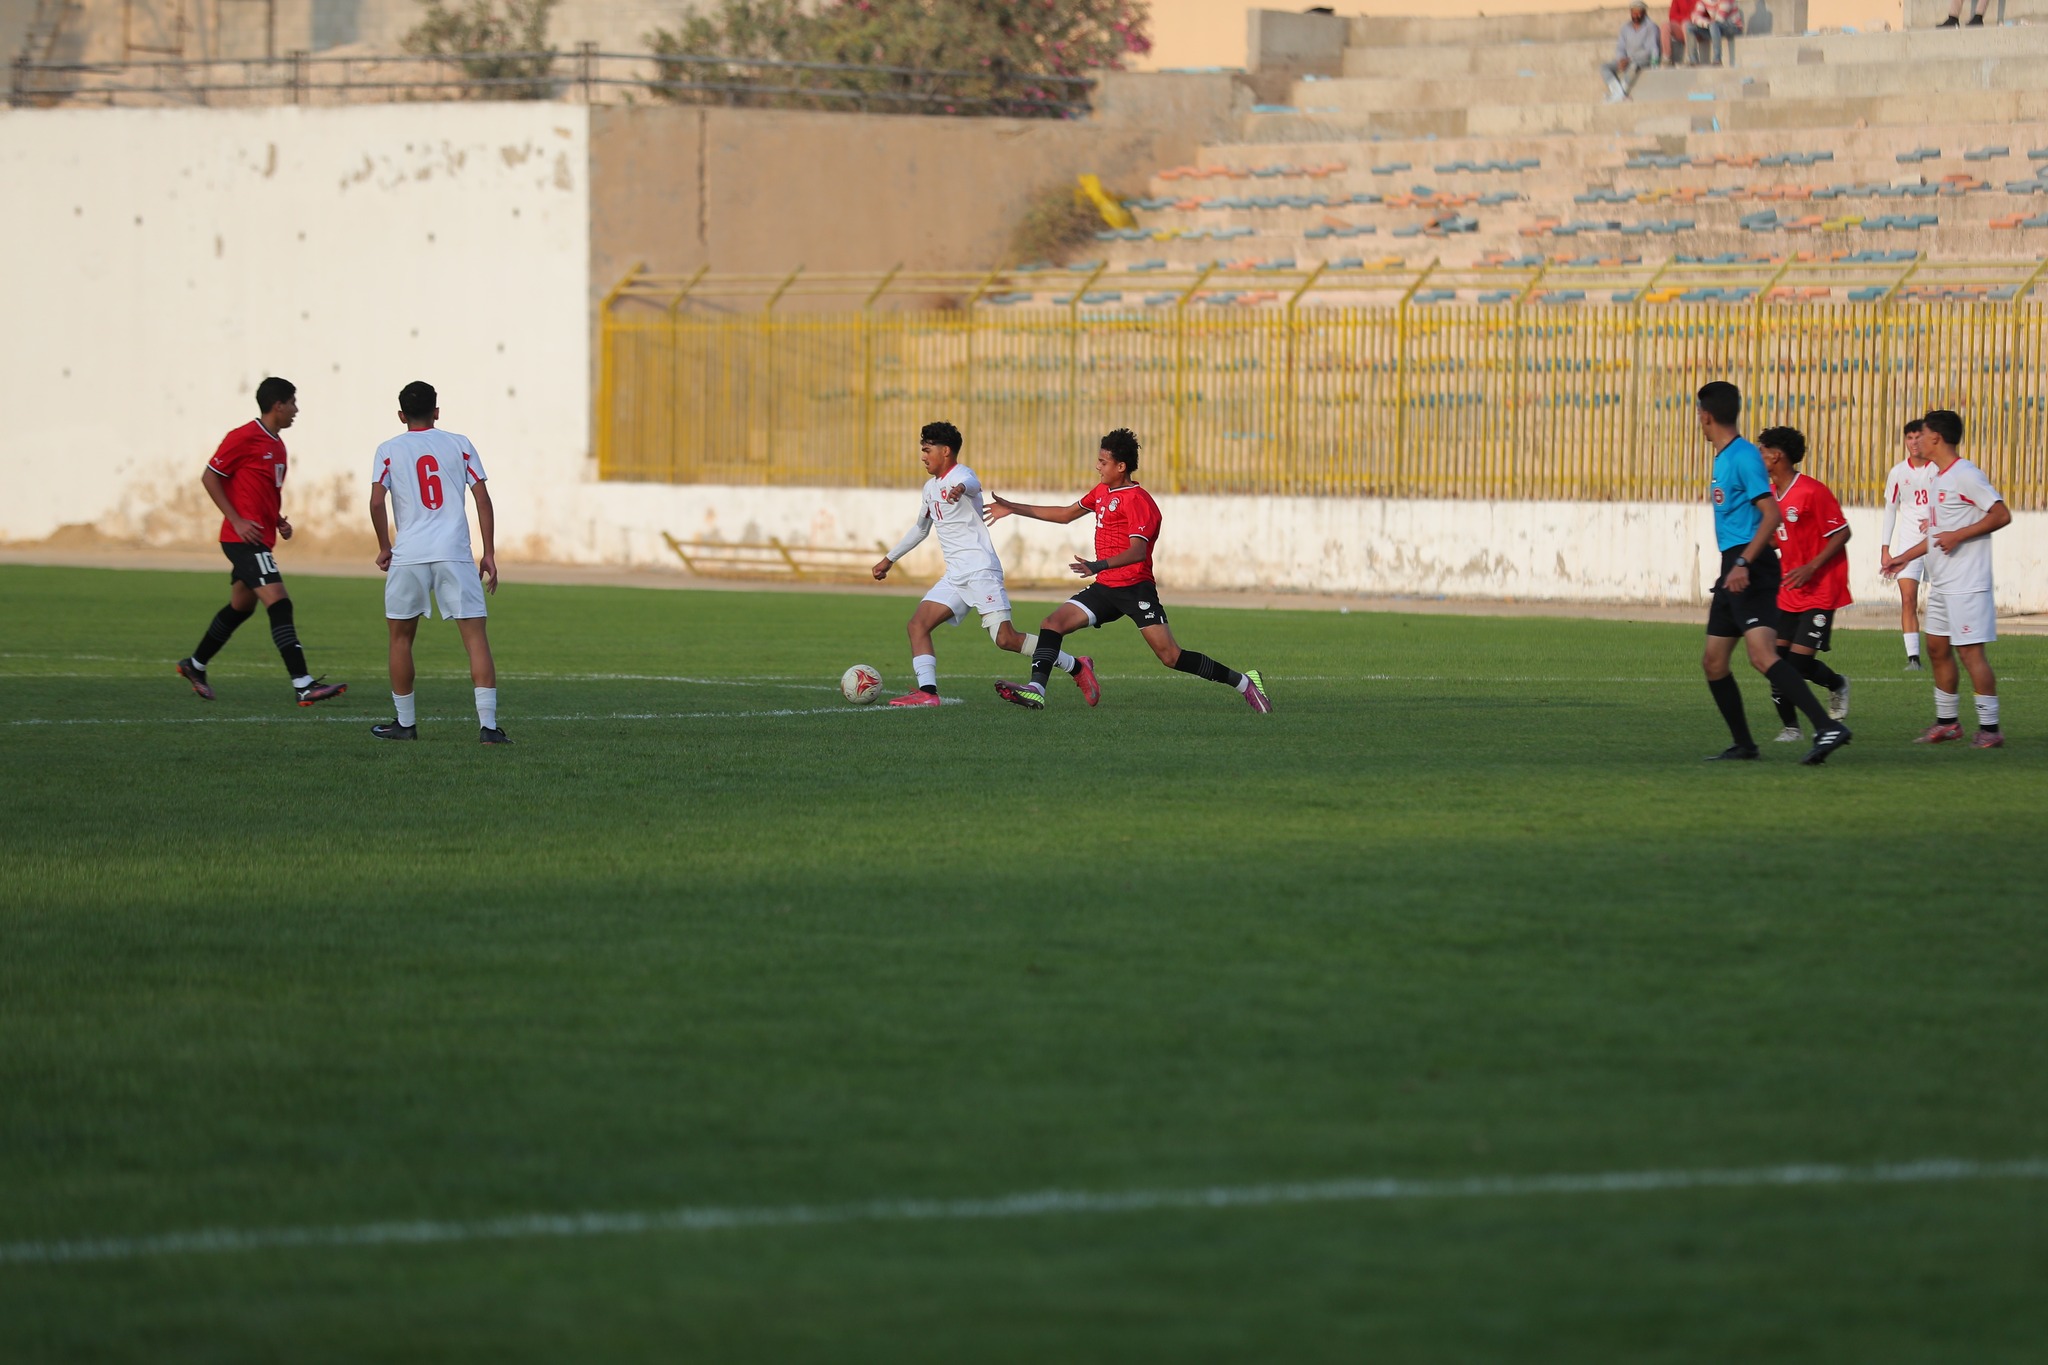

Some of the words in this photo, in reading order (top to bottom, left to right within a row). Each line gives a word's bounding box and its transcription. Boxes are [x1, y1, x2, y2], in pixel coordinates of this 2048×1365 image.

[416, 455, 443, 510] 6
[1915, 490, 1928, 505] 23
[935, 501, 943, 520] 11
[1097, 506, 1105, 528] 2
[255, 552, 278, 574] 10
